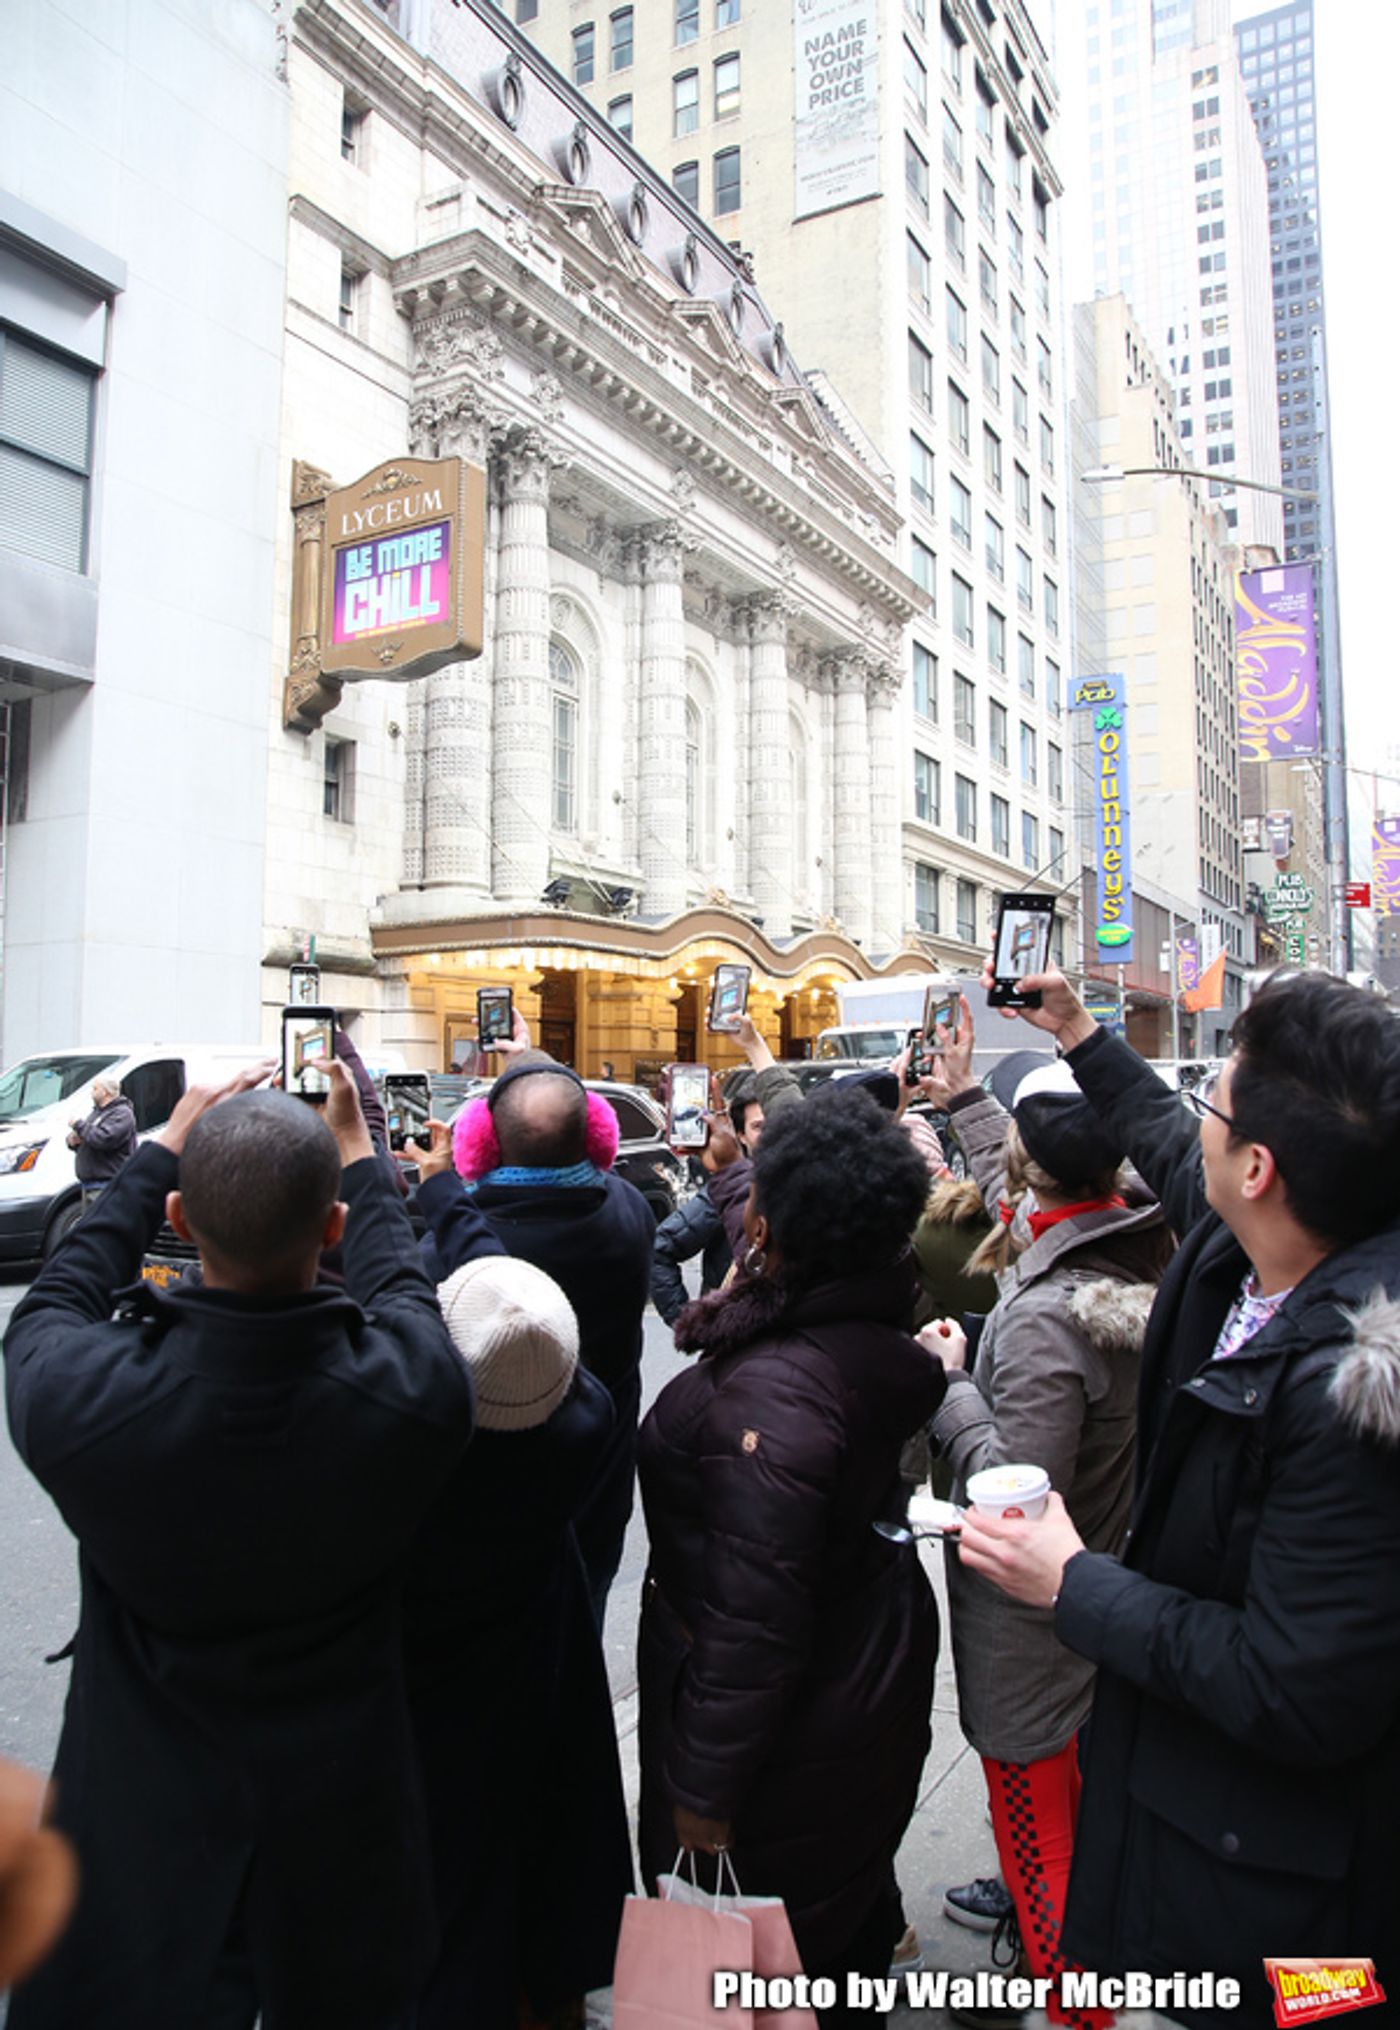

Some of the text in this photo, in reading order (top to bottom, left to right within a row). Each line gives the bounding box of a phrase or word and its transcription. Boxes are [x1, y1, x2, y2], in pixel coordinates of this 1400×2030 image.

[804, 18, 867, 56] NAME
[808, 39, 864, 72] YOUR
[809, 58, 863, 90] OWN
[809, 76, 864, 109] PRICE
[341, 489, 443, 536] LYCEUM
[345, 528, 442, 583] BE MORE
